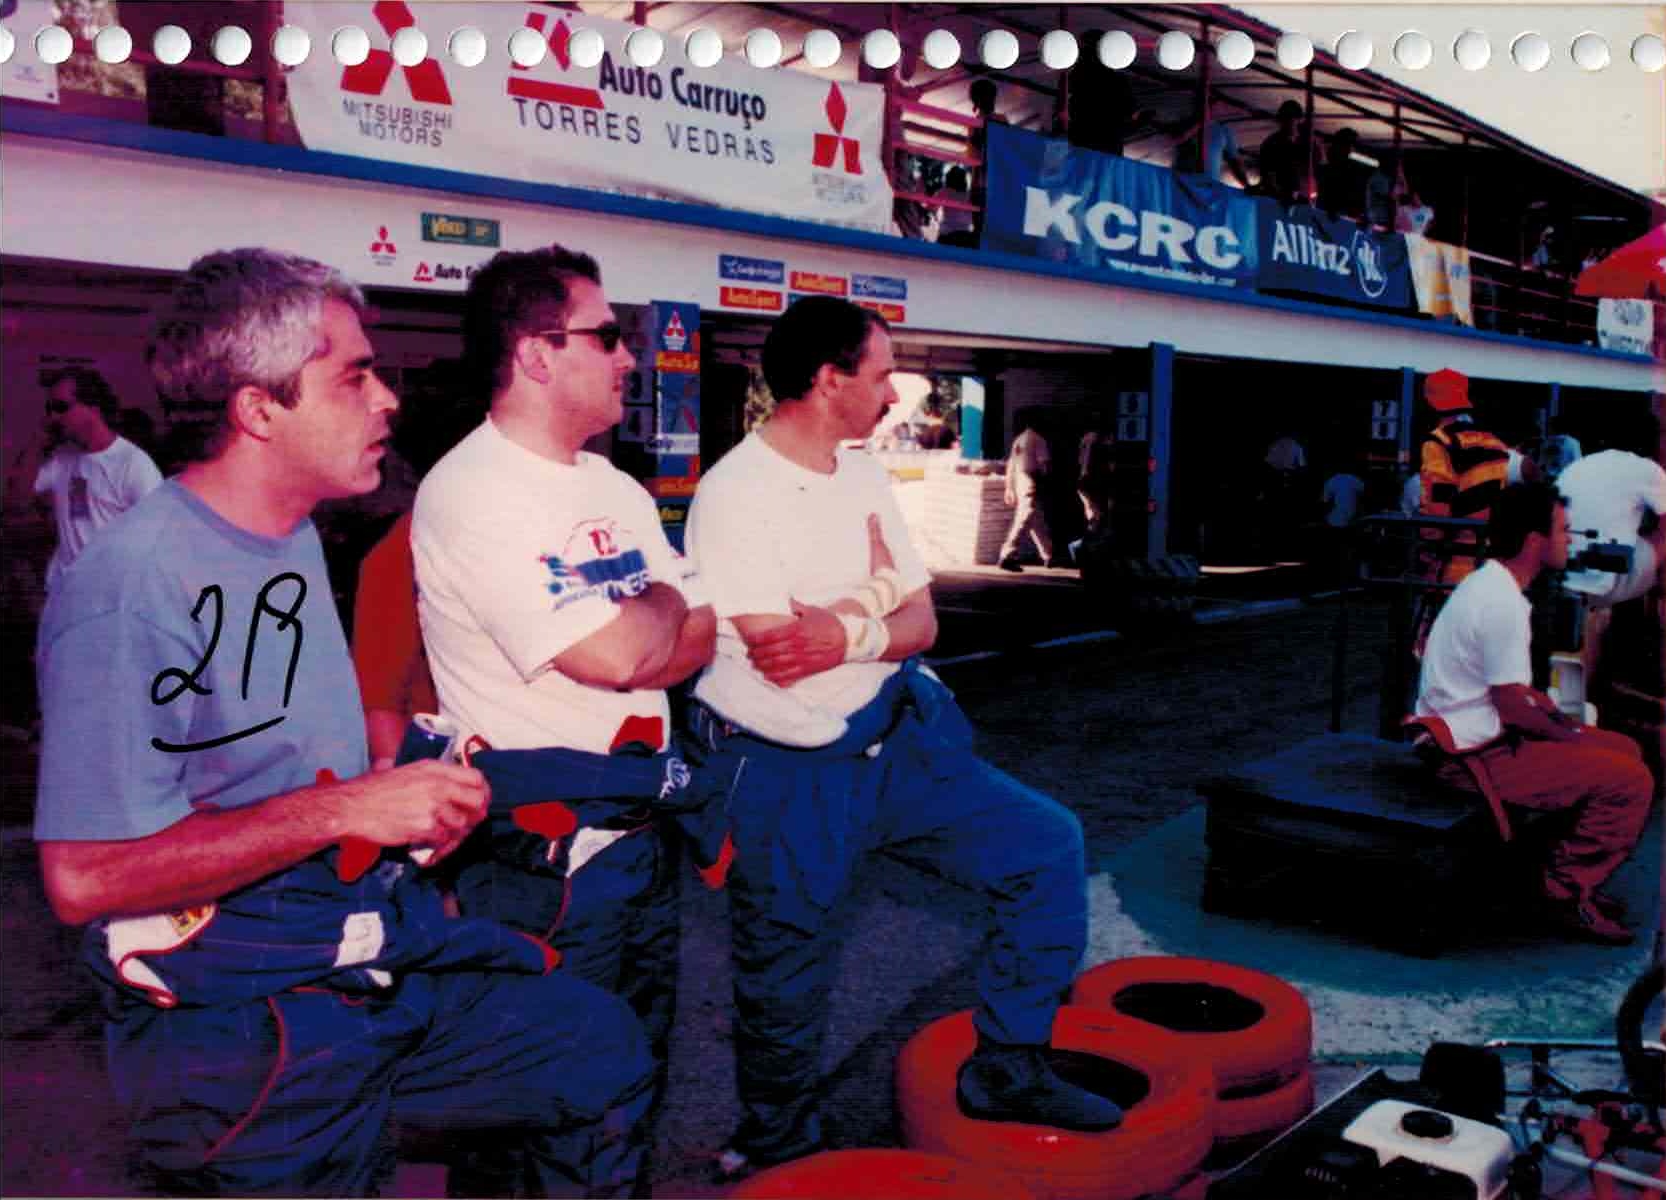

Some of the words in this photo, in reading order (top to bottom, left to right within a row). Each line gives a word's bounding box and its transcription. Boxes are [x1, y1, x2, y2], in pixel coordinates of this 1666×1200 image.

[342, 97, 453, 129] MITSUBISHI
[599, 50, 663, 100] Auto
[670, 66, 766, 130] Carruço
[358, 119, 443, 147] MOTORS
[513, 97, 641, 144] TORRES
[665, 121, 775, 164] VEDRAS
[1022, 185, 1242, 269] KCRC
